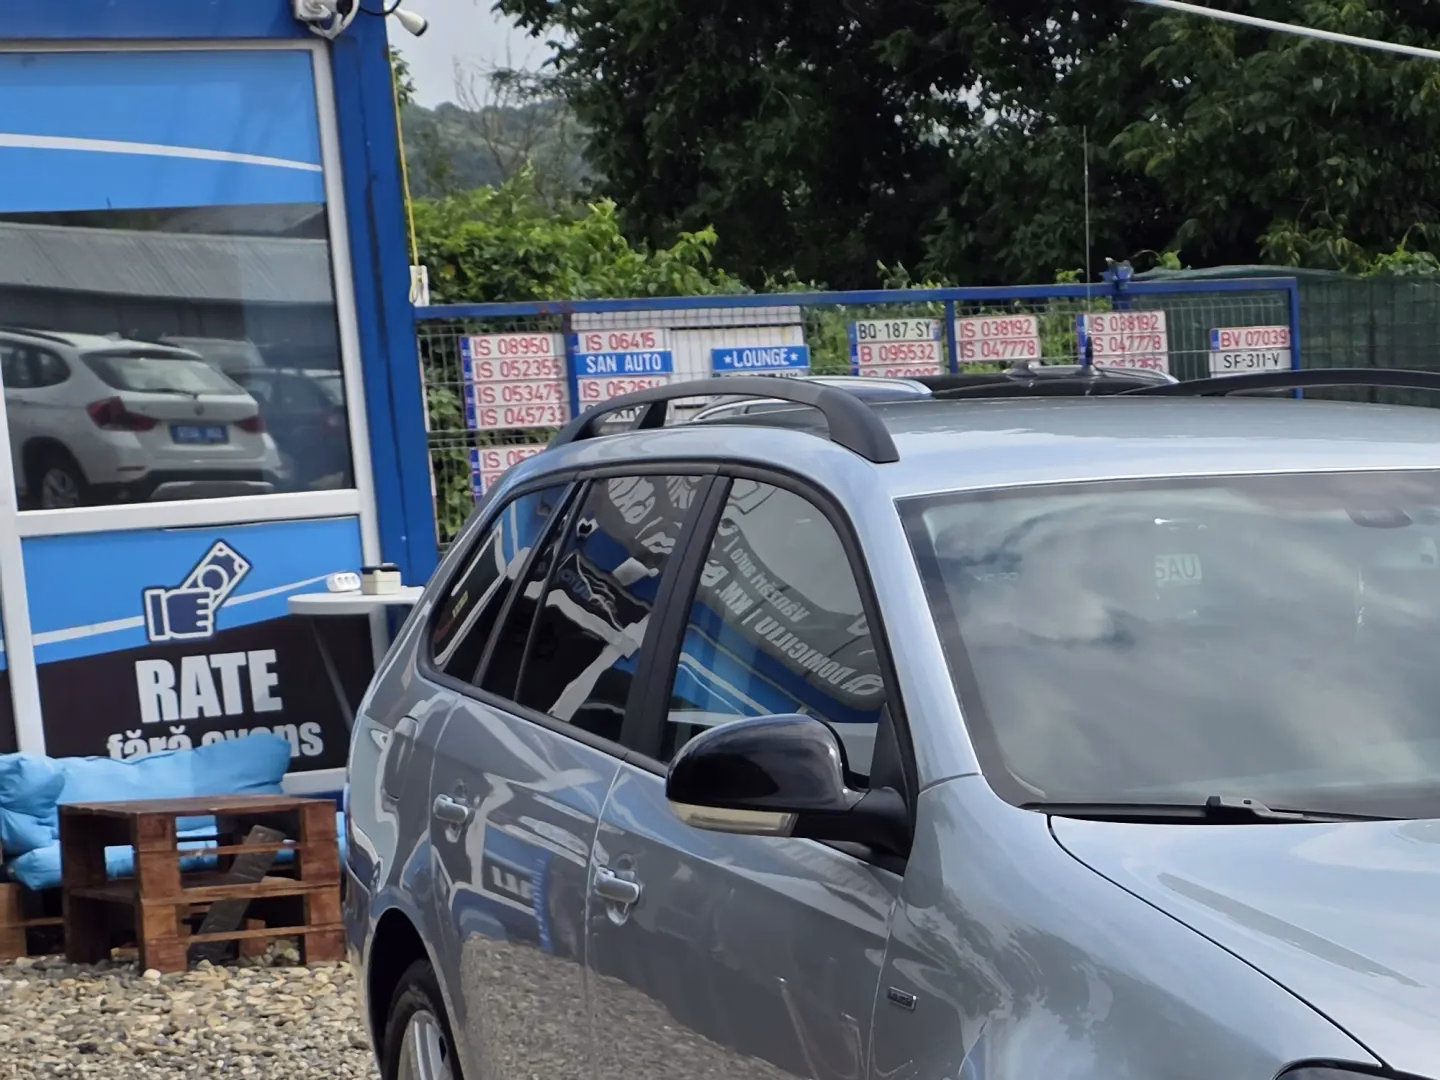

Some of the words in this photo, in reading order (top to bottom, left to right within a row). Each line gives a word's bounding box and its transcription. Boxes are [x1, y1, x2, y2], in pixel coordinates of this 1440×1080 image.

[960, 322, 976, 338] IS
[981, 319, 1032, 336] 038192
[1110, 314, 1159, 331] 038192
[473, 338, 491, 356] IS
[497, 337, 550, 355] 08950
[585, 334, 603, 352] IS
[608, 332, 656, 350] 06415
[1093, 337, 1104, 353] S
[1220, 331, 1241, 347] BV
[732, 348, 790, 367] LOUNGE
[861, 346, 873, 362] B
[878, 343, 934, 361] 095532
[960, 341, 975, 358] IS
[981, 340, 1035, 357] 047778
[475, 361, 493, 379] IS
[586, 355, 617, 373] SAN
[624, 353, 662, 372] AUTO
[477, 387, 496, 404] IS
[502, 384, 564, 402] 053475
[582, 381, 600, 398] IS
[481, 408, 498, 426] IS
[504, 406, 566, 425] 045733
[483, 452, 500, 468] IS
[135, 648, 283, 724] RATE
